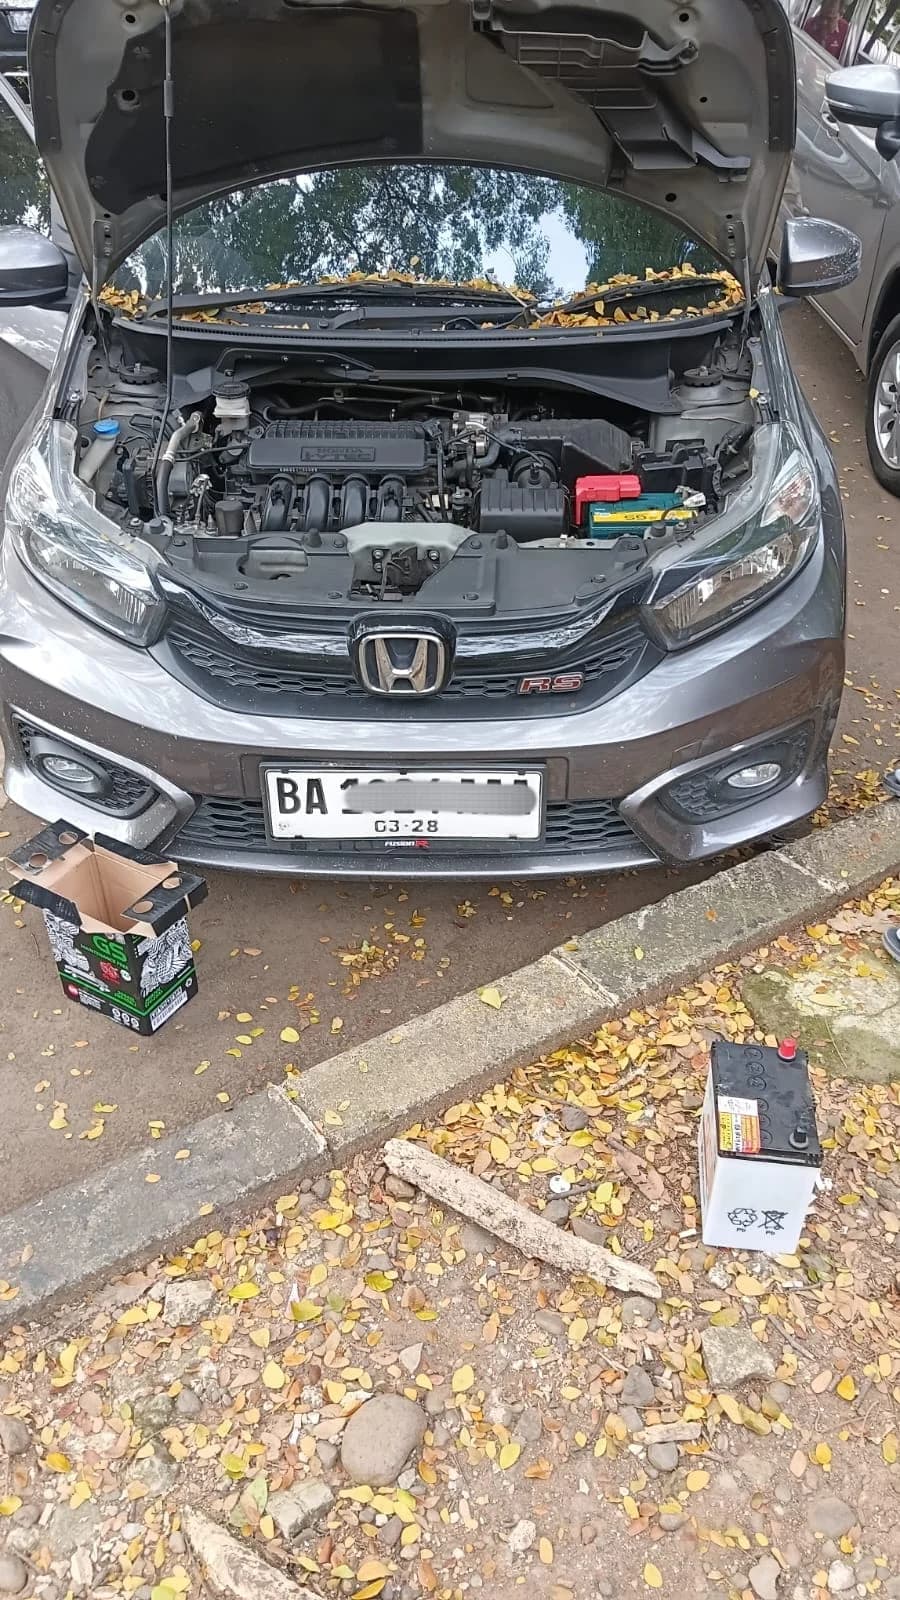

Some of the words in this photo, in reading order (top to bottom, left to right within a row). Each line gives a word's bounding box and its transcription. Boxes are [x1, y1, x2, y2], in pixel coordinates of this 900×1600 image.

[518, 672, 584, 695] RS
[276, 777, 329, 815] BA
[92, 934, 128, 962] GS
